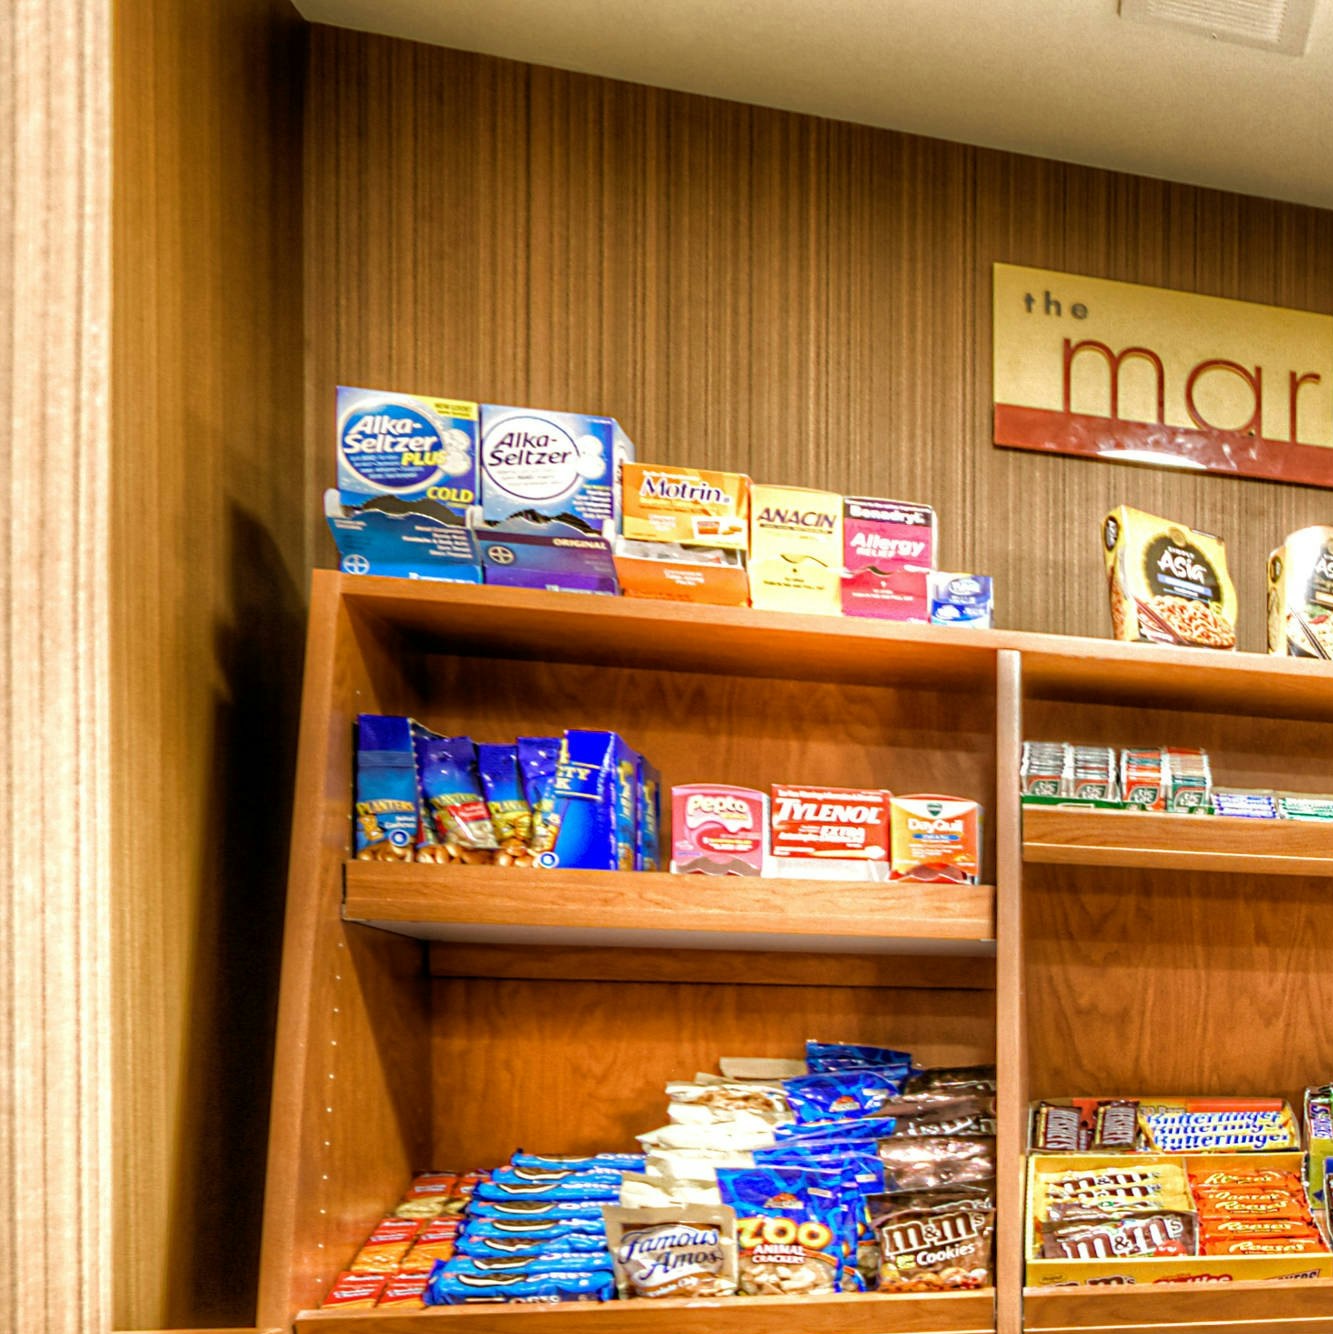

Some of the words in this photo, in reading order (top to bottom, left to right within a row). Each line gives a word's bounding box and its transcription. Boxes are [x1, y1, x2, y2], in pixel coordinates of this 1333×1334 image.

[1023, 291, 1090, 320] the
[349, 416, 423, 435] Alka-
[343, 434, 438, 454] Seltzer
[496, 432, 557, 448] Alka-
[402, 451, 448, 466] PLUS
[488, 450, 571, 467] Seltzer
[427, 487, 473, 503] COLD
[640, 477, 722, 503] Motrin
[757, 507, 836, 528] ANACIN
[553, 538, 608, 550] ORIGINAL
[850, 533, 926, 558] Allergy
[1157, 550, 1207, 584] Asia
[775, 798, 882, 824] TYLENOL
[908, 818, 964, 833] DayQuil
[738, 1217, 833, 1250] ZOO
[619, 1228, 719, 1264] Famous
[753, 1244, 805, 1256] ANIMAL
[916, 1243, 976, 1267] Cookies
[650, 1248, 723, 1280] Amos
